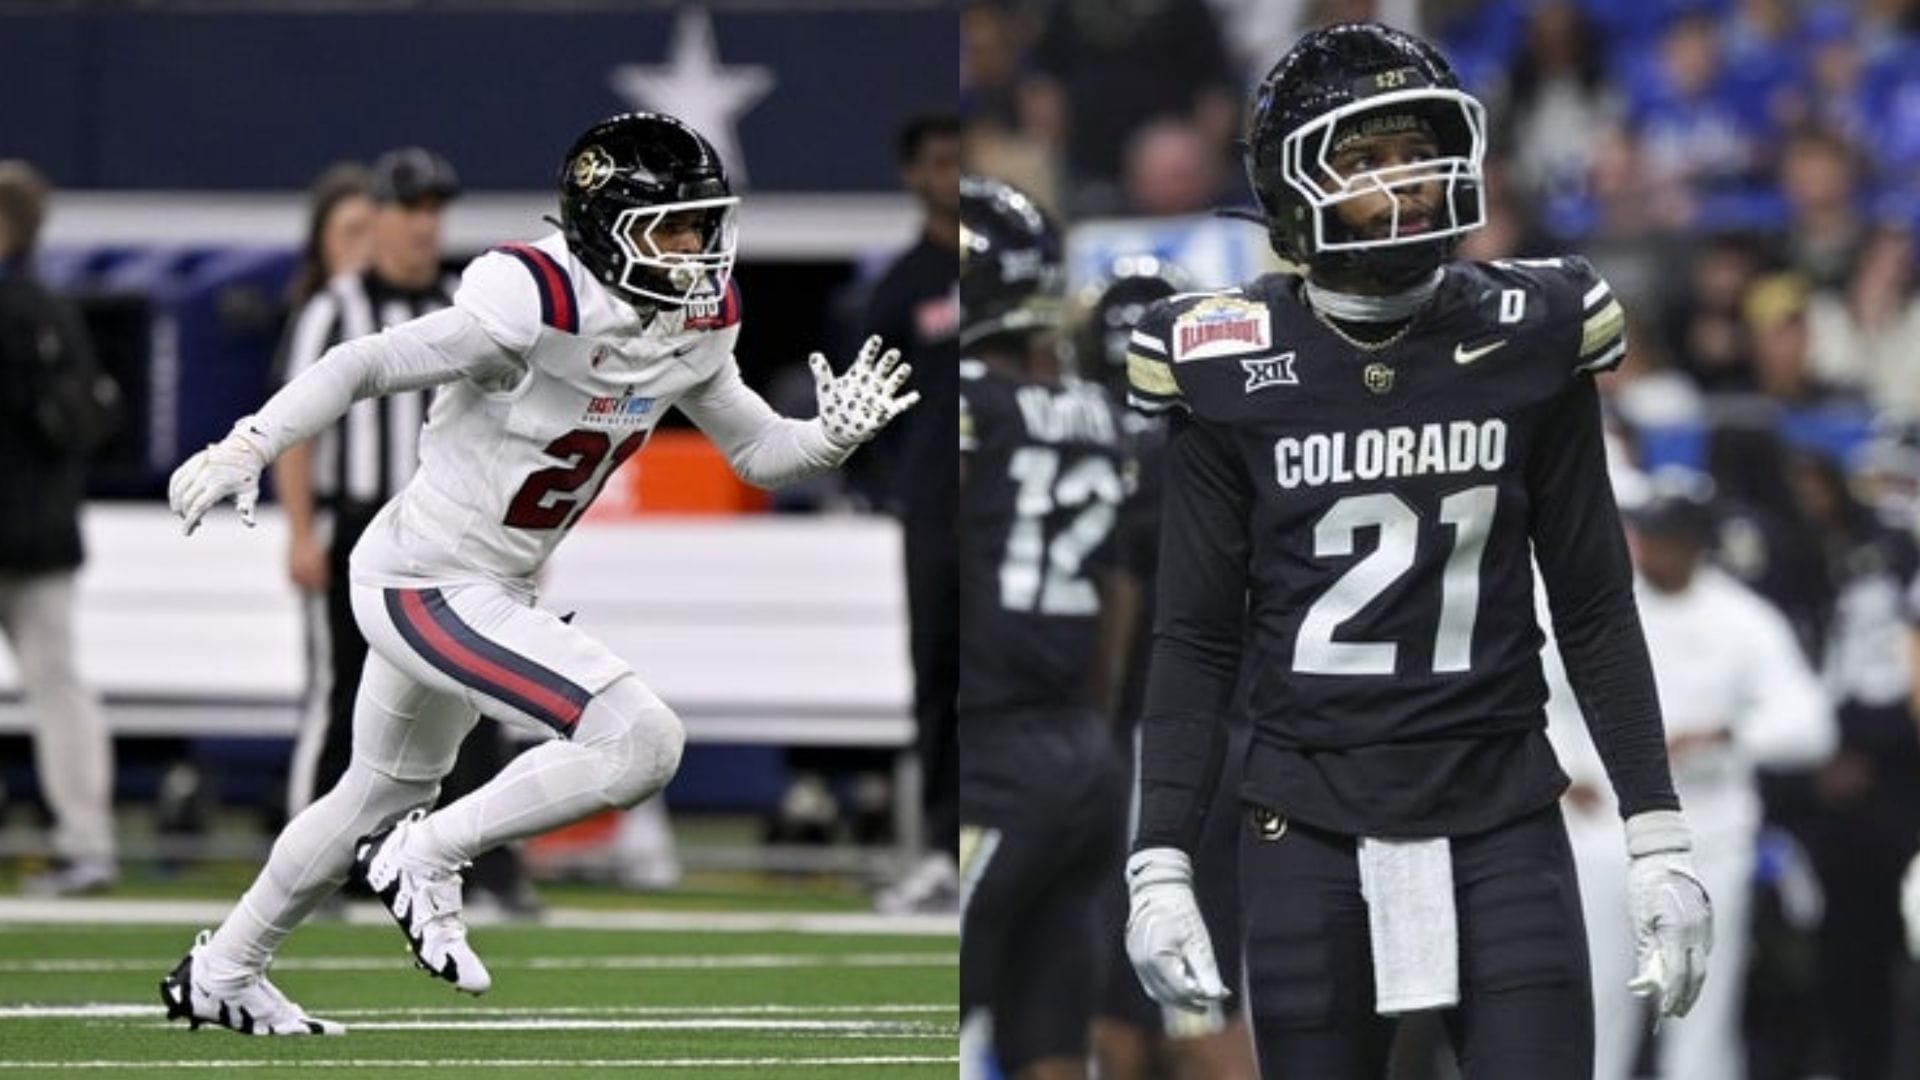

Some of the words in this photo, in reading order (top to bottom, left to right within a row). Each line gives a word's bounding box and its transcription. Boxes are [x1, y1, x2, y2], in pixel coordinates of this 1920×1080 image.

[1499, 288, 1526, 323] D
[1275, 419, 1508, 489] COLORADO
[999, 447, 1125, 616] 12
[1292, 485, 1499, 675] 21
